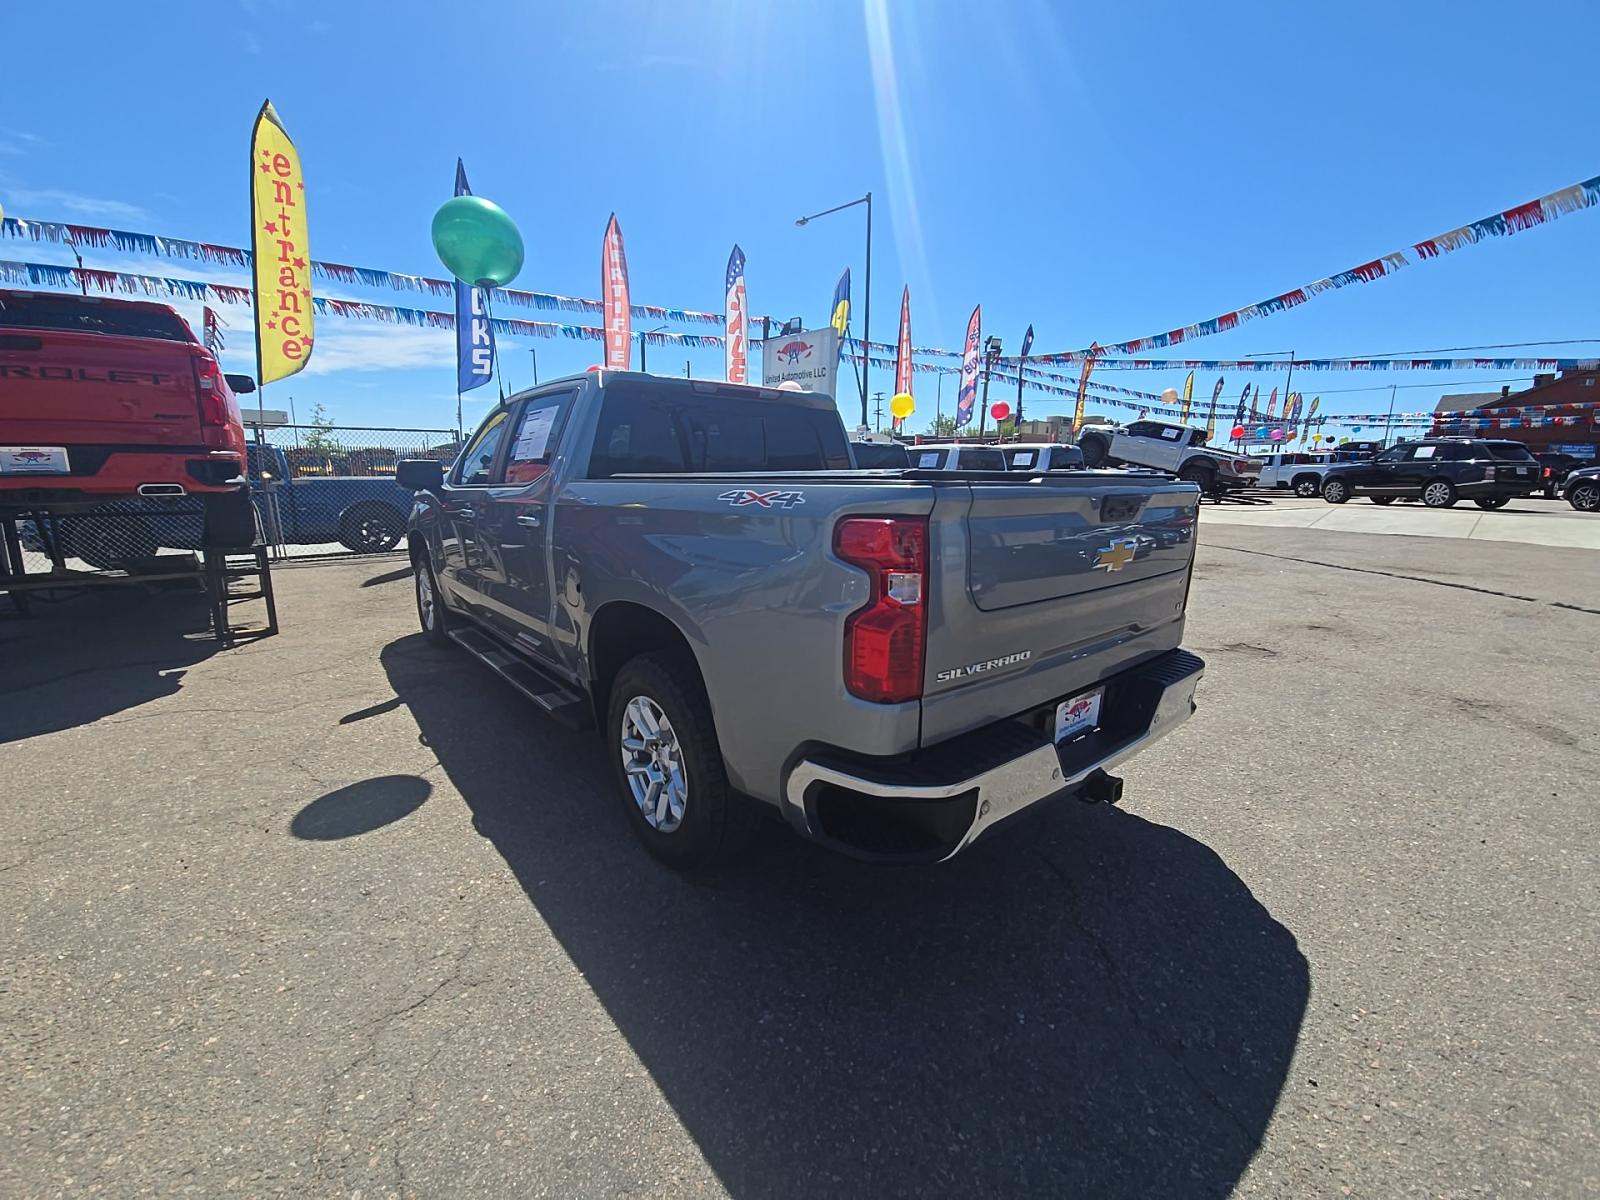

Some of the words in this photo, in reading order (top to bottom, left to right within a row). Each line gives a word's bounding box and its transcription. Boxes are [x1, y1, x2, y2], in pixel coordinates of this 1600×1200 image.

[272, 152, 302, 360] entrance
[765, 373, 780, 384] United
[781, 369, 813, 381] Automotive
[814, 367, 827, 378] LLC
[936, 650, 1032, 682] SILVERADO
